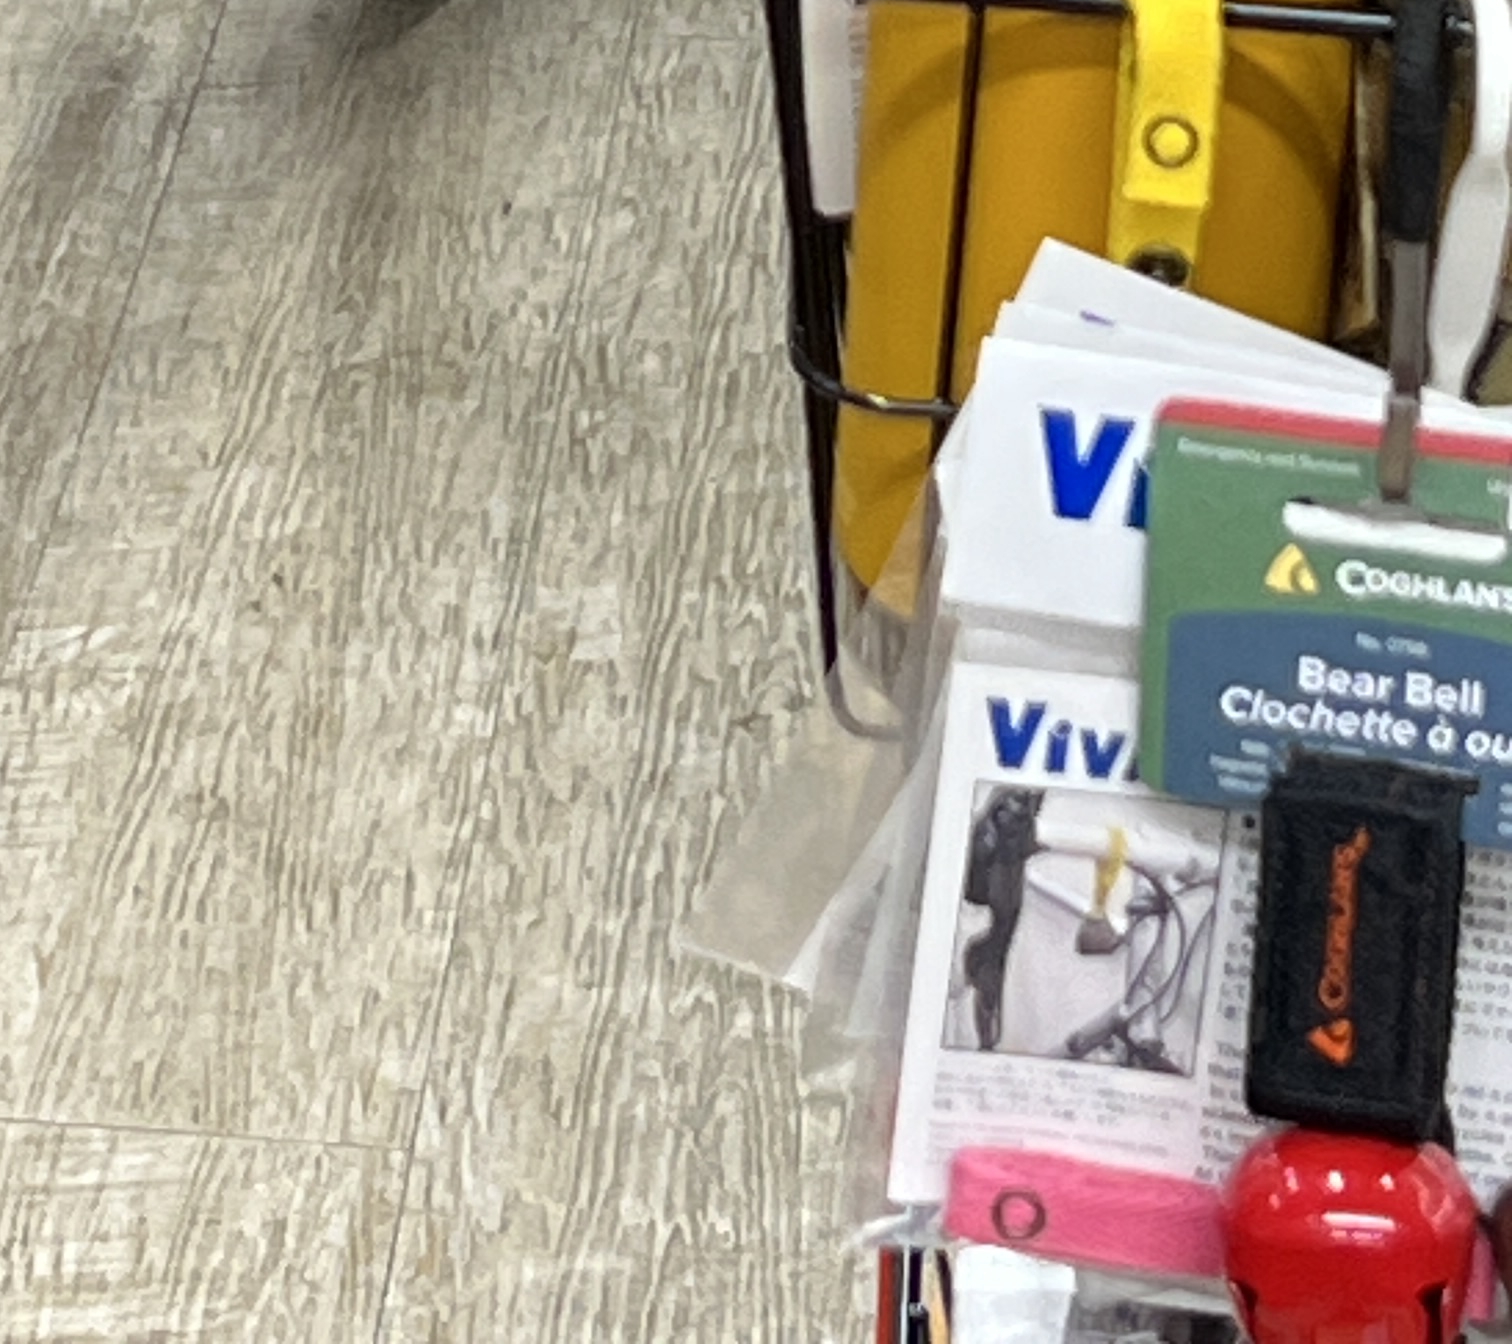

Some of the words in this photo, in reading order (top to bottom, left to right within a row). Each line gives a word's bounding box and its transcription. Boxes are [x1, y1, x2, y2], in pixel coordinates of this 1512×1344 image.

[1219, 684, 1419, 747] Clochette
[1426, 714, 1457, 753] à
[1297, 654, 1394, 703] Bear
[1405, 670, 1485, 718] Bell
[986, 697, 1140, 782] Viv
